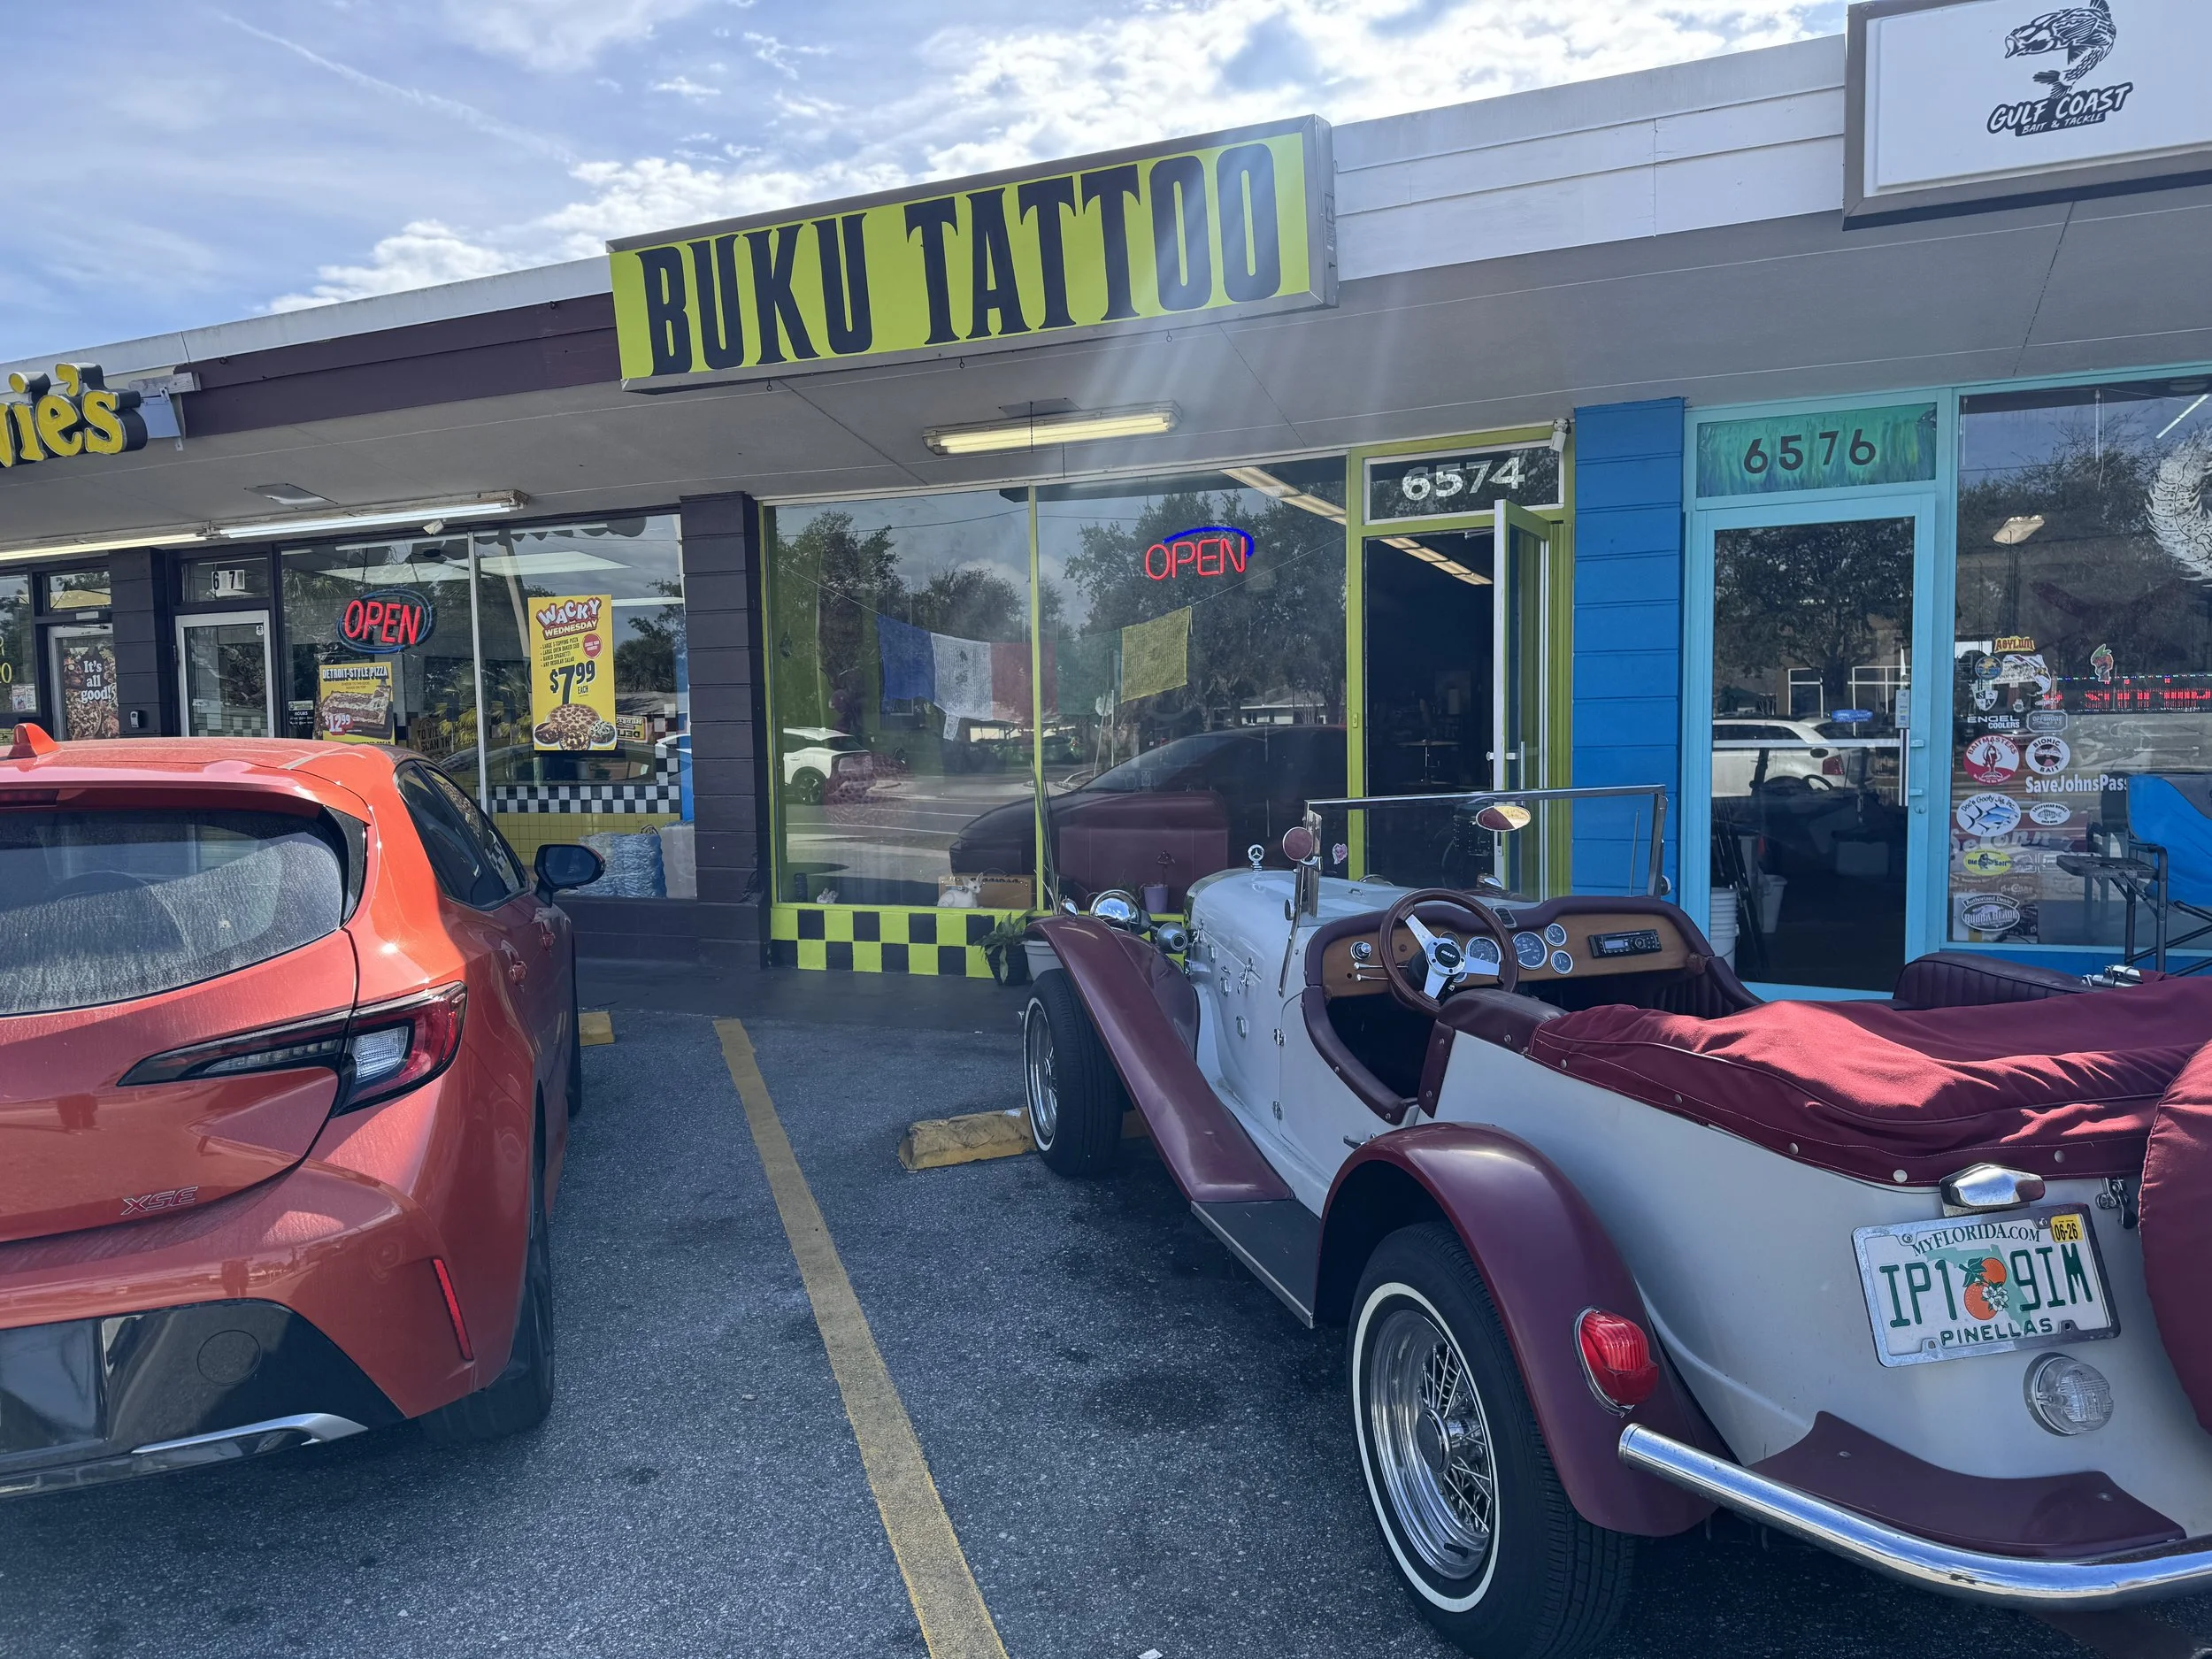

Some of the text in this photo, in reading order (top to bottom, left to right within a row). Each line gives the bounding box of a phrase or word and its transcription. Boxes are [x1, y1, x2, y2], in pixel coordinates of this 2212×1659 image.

[1990, 85, 2131, 131] GULF COAST
[2022, 112, 2104, 134] BAIT & TACKLE
[635, 142, 1281, 376] BUKU TATTOO
[1743, 428, 1877, 474] 6576
[1402, 456, 1525, 501] 6574
[1145, 536, 1247, 580] OPEN
[344, 599, 422, 645] OPEN
[537, 600, 601, 626] WACKY
[544, 620, 598, 637] WEDNESDAY
[83, 660, 103, 673] It's
[323, 665, 388, 680] DETROIT-STYLE PIZZA
[86, 674, 102, 687] all
[577, 685, 589, 695] EACH
[81, 686, 111, 704] good!
[1967, 715, 2020, 724] ENGEL
[421, 738, 439, 752] SCAN
[1967, 736, 2017, 756] BAITMASTERS
[2032, 738, 2061, 748] BIONIC
[1976, 795, 1995, 803] Goofy
[1966, 895, 2015, 906] Authorized Dealer
[120, 1186, 199, 1216] XSE
[1911, 1223, 2041, 1257] MYFLORIDA.COM
[2054, 1222, 2078, 1241] 06-26
[1879, 1242, 2094, 1328] IP1 9IM
[1939, 1317, 2054, 1346] PINELLAS
